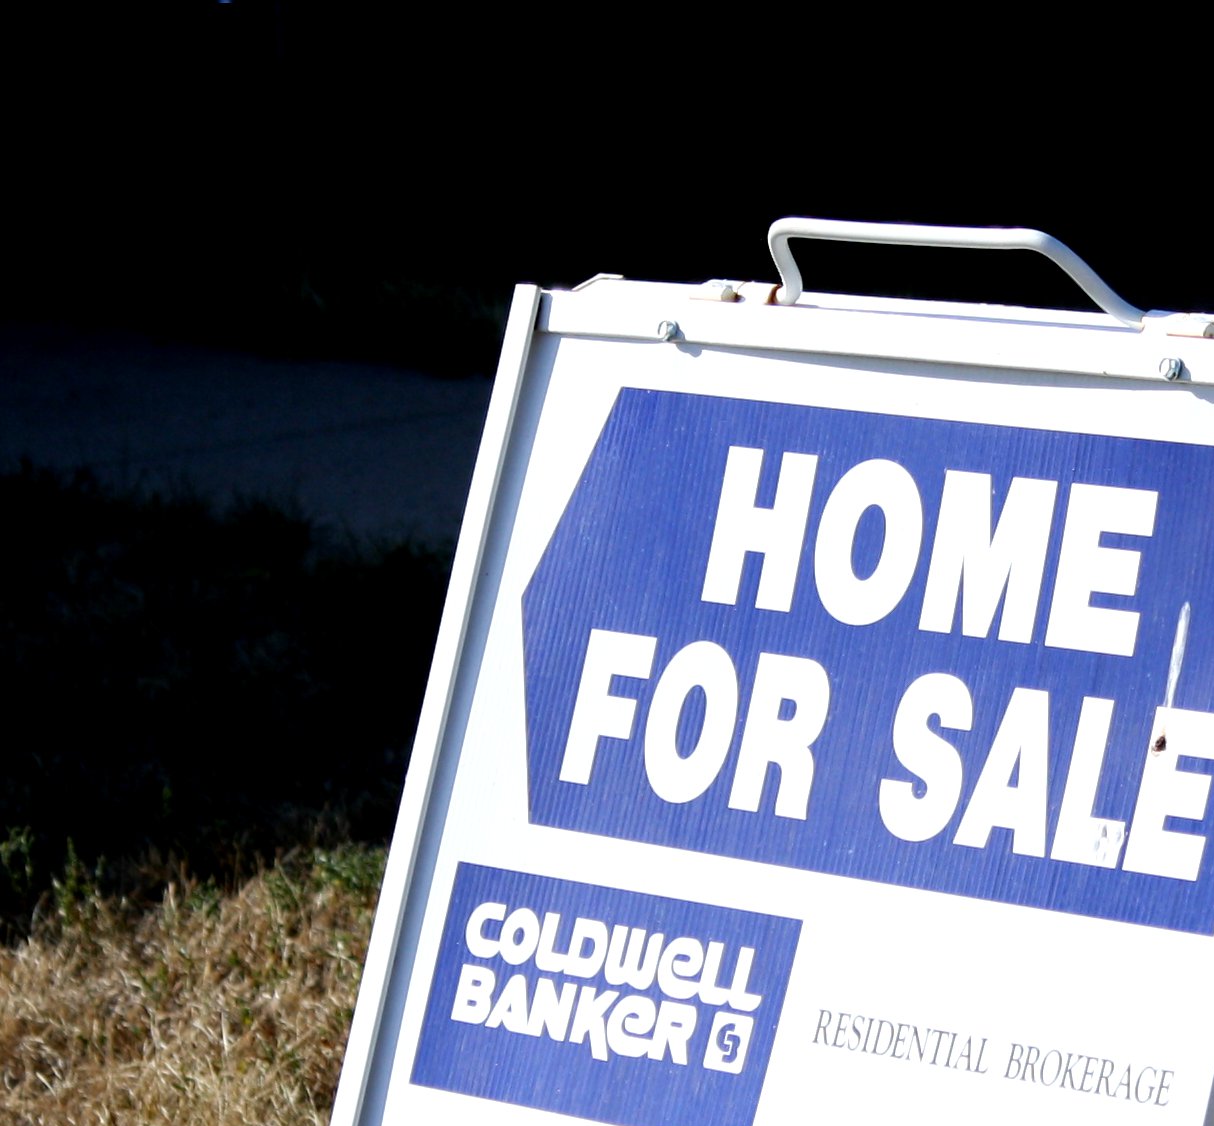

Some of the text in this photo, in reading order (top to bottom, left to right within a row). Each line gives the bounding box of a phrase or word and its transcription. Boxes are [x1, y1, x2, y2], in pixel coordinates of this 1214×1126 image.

[700, 445, 1158, 657] HOME
[558, 628, 829, 820] FOR
[812, 1009, 989, 1074] RESIDENTIAL
[1004, 1043, 1174, 1106] BROKERAGE
